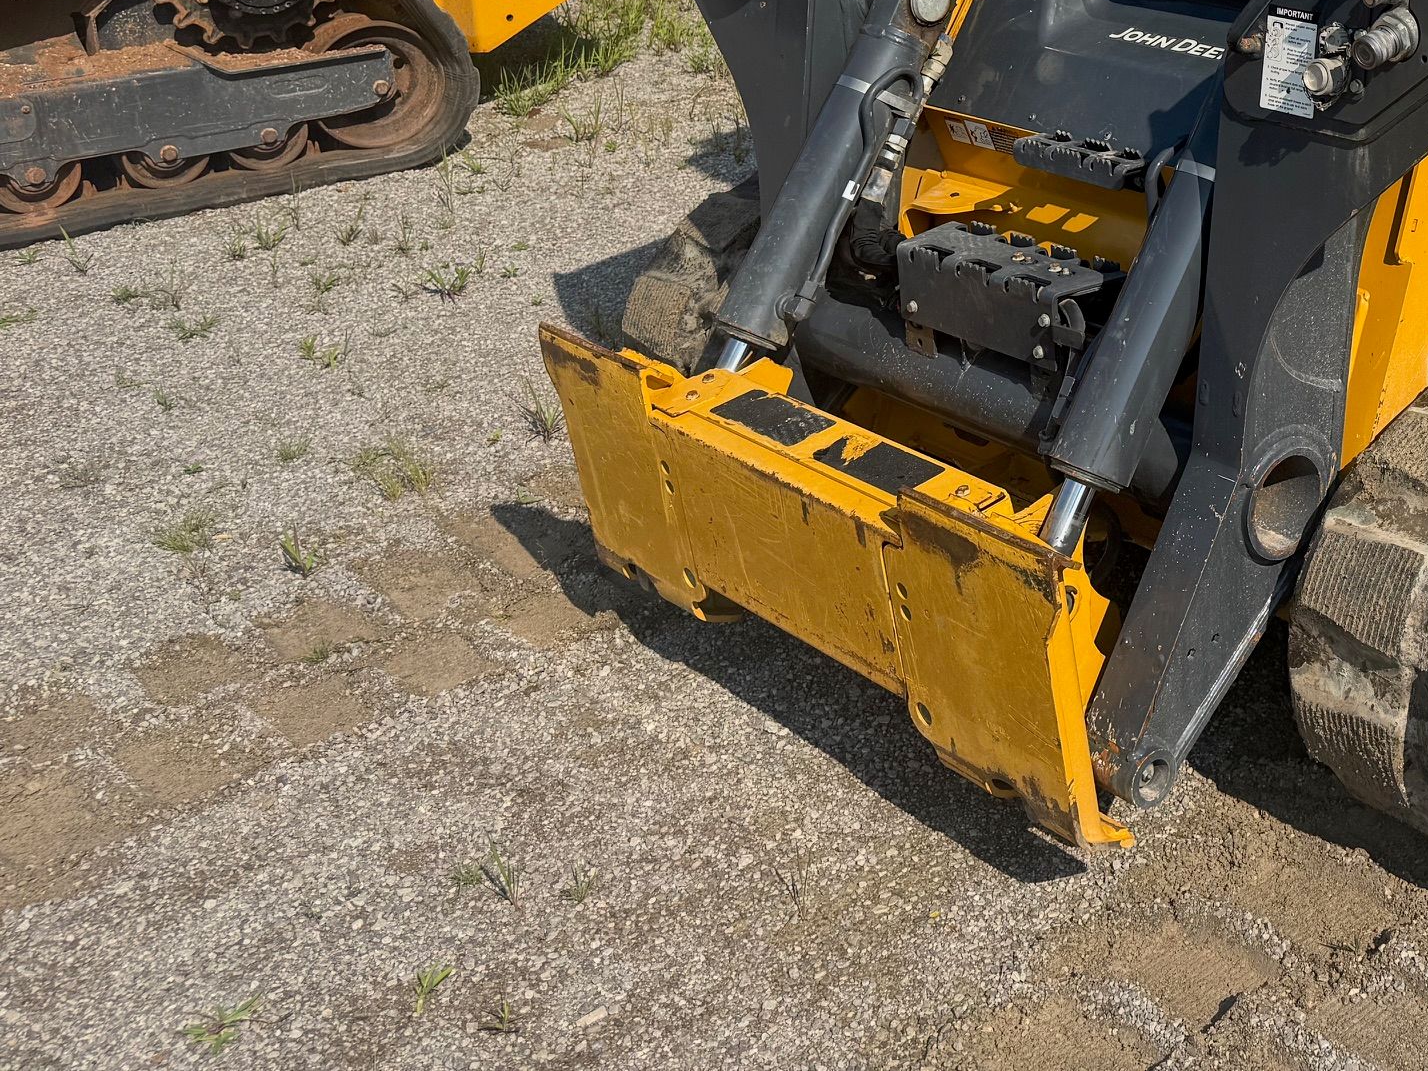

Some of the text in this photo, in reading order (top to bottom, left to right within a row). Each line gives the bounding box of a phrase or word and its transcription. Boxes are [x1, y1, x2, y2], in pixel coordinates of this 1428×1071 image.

[1276, 7, 1314, 21] IMPORTANT
[1109, 27, 1225, 60] JOHN DEE
